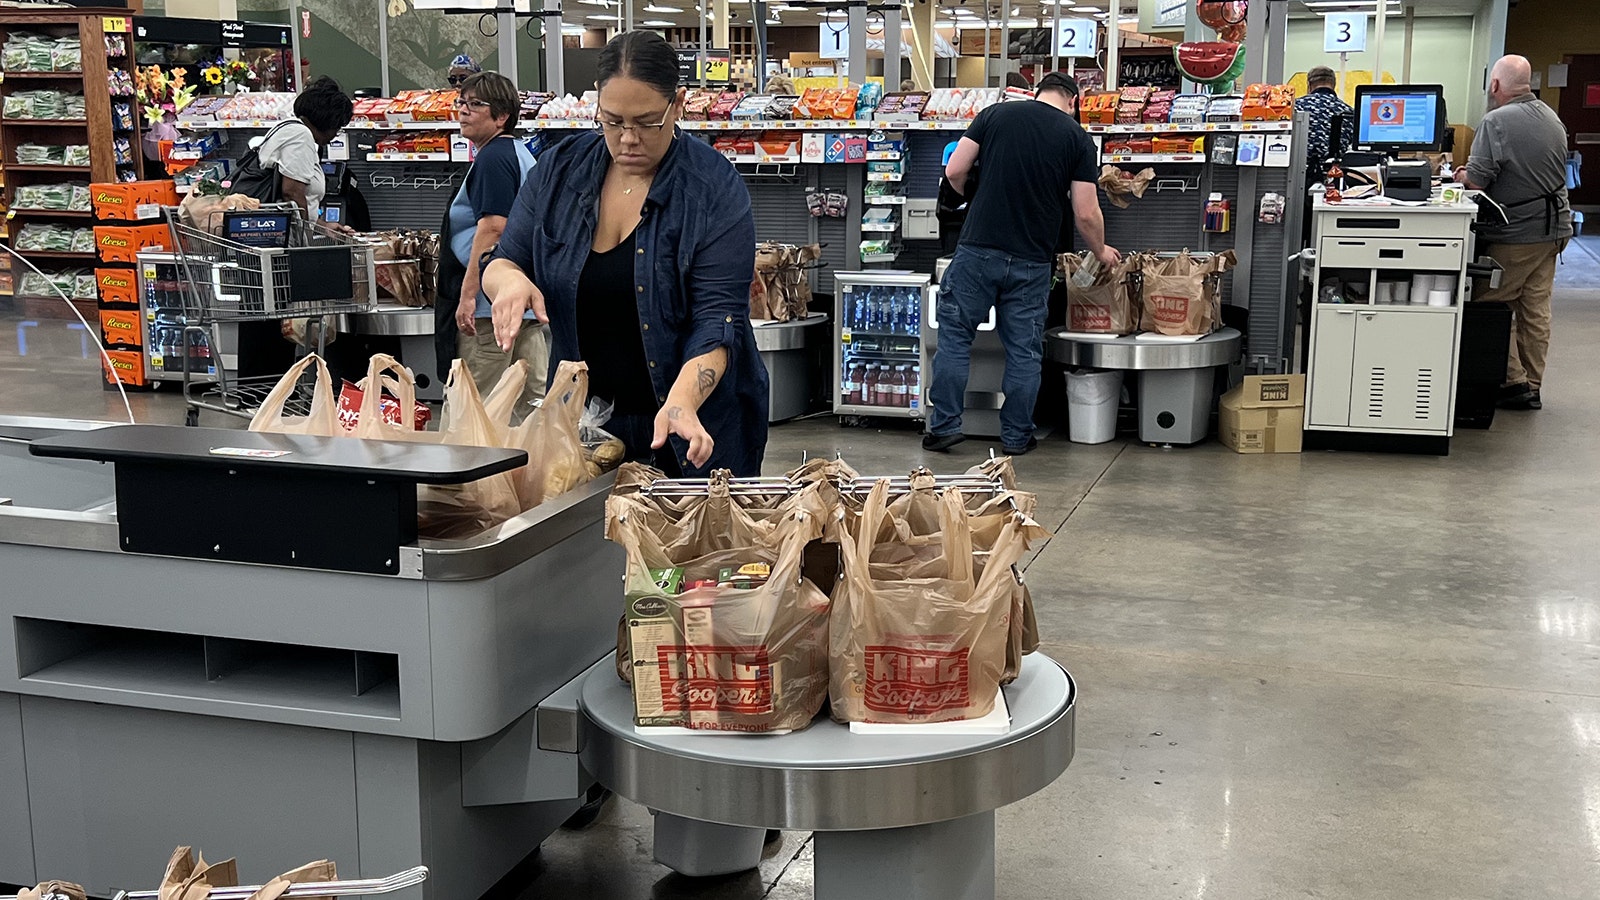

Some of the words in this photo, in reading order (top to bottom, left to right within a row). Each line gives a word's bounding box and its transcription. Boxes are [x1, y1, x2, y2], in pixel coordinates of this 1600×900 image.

[832, 30, 840, 50] 1
[1062, 28, 1076, 48] 2
[1337, 22, 1351, 42] 3
[240, 220, 276, 229] SOLAR
[1262, 392, 1287, 400] KING
[667, 652, 761, 680] KING
[873, 653, 961, 685] KING
[670, 680, 765, 709] Soopers
[868, 681, 962, 712] Soopers
[699, 721, 719, 731] FOR
[721, 721, 769, 733] EVERYONE
